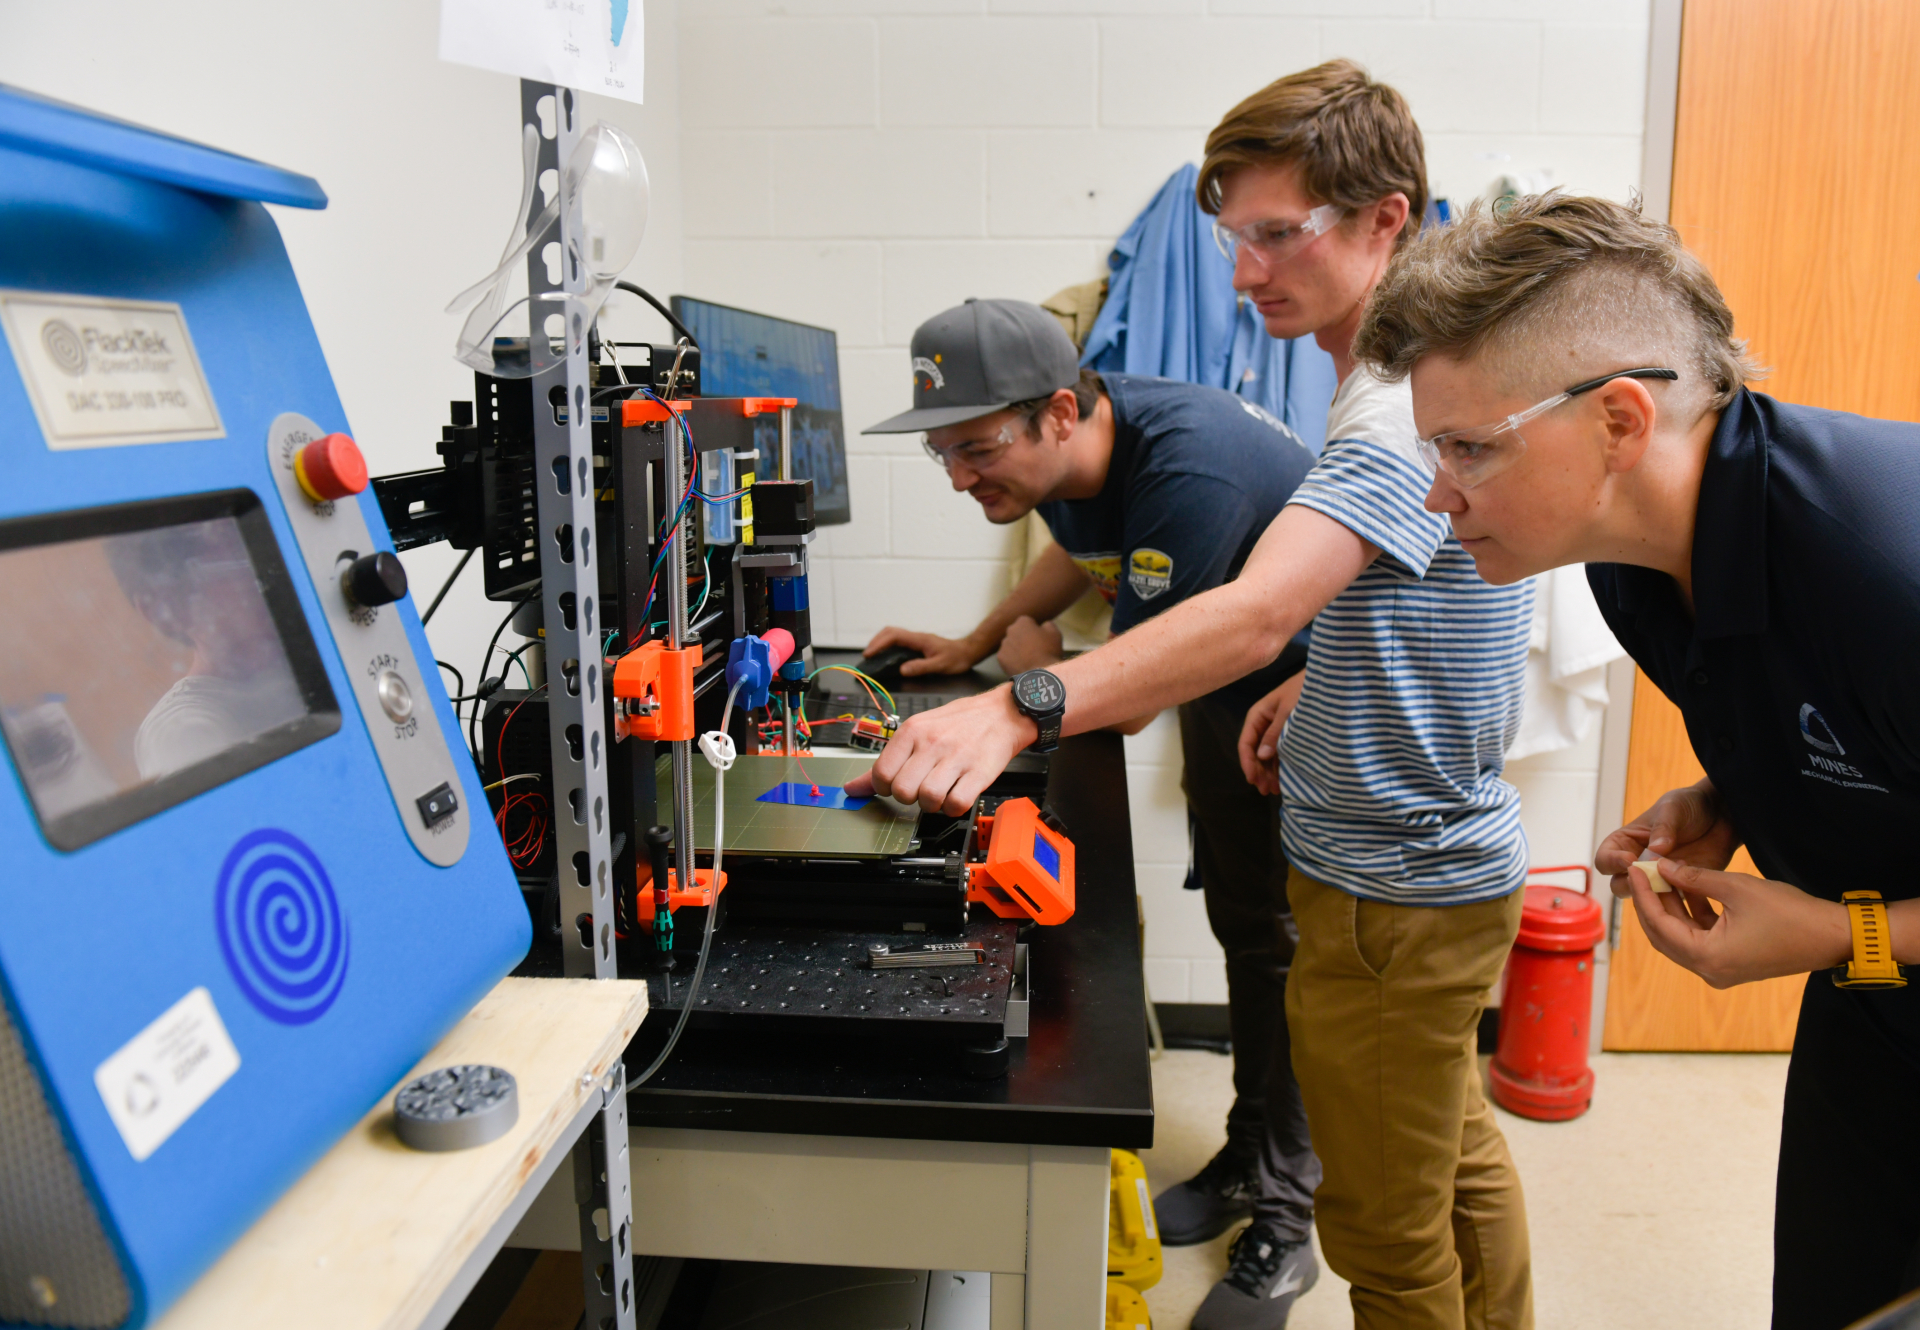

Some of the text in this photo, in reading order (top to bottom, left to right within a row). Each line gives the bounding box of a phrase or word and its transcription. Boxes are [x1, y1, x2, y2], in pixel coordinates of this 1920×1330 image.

[313, 501, 336, 518] STOP
[348, 606, 378, 626] SPEED
[367, 653, 399, 680] START
[1039, 685, 1058, 702] 12
[394, 717, 418, 740] STOP
[1808, 753, 1863, 778] MINES
[430, 814, 456, 837] POWER
